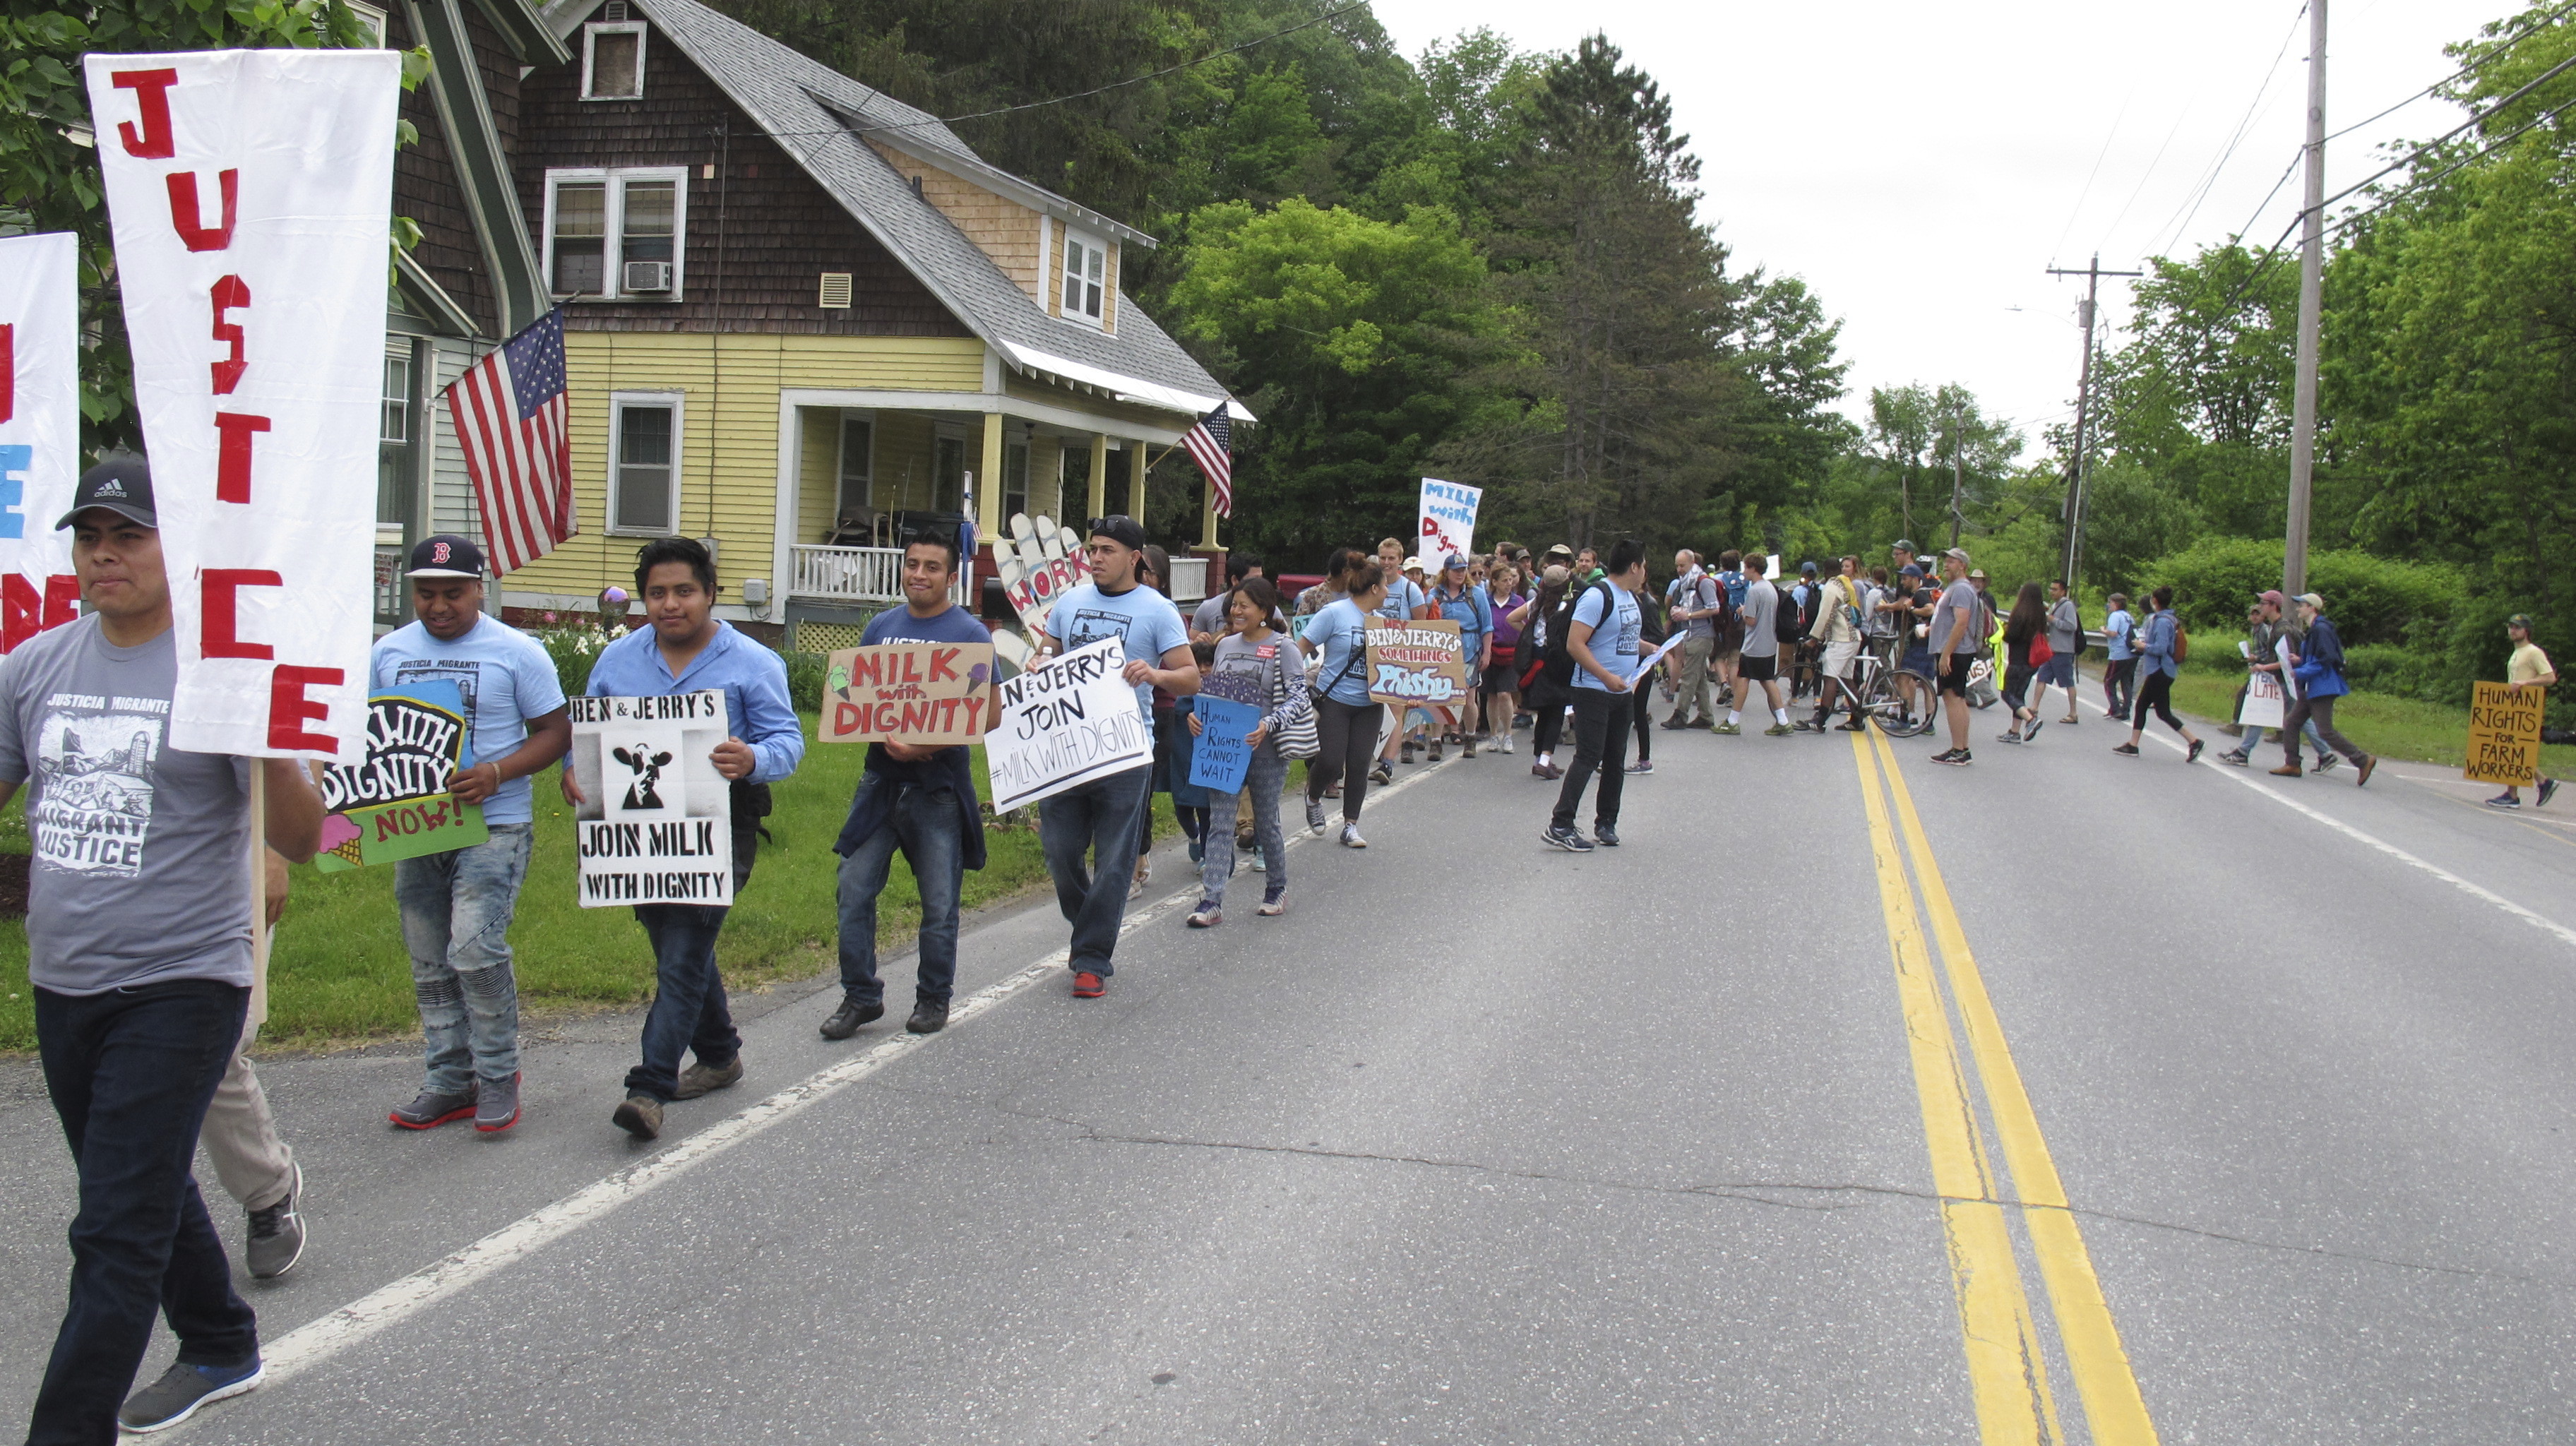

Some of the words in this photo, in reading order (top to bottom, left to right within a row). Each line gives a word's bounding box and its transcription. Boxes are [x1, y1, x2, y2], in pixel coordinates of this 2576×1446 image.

[94, 489, 128, 498] adidas
[1429, 505, 1473, 525] with
[1422, 517, 1462, 555] Digni
[1006, 546, 1092, 612] WORK
[1383, 619, 1409, 631] HEY
[398, 659, 431, 669] JUSTICIA
[437, 659, 480, 669] MIGRANTE
[852, 647, 961, 688] MILK
[47, 693, 105, 710] JUSTICIA
[111, 696, 170, 714] MIGRANTE
[876, 683, 926, 701] with
[2254, 683, 2280, 700] LATE
[2479, 688, 2538, 709] HUMAN
[572, 697, 612, 722] BEN
[616, 702, 628, 717] &
[834, 696, 986, 736] DIGNITY
[1017, 689, 1085, 740] JOIN
[2472, 707, 2536, 733] RIGHTS
[374, 705, 458, 759] WITH
[1037, 729, 1082, 775] WITH
[1081, 707, 1145, 762] DIGNITY
[2495, 732, 2515, 744] FOR
[1198, 748, 1241, 765] CANNOT
[2481, 743, 2524, 765] FARM
[321, 753, 455, 810] DIGNITY
[1201, 763, 1234, 783] WAIT
[2467, 759, 2533, 781] WORKERS
[375, 798, 463, 842] NOW!
[38, 830, 141, 867] JUSTICE
[582, 823, 640, 858] JOIN
[649, 821, 714, 857] MILK
[586, 873, 638, 900] WITH
[644, 872, 725, 898] DIGNITY
